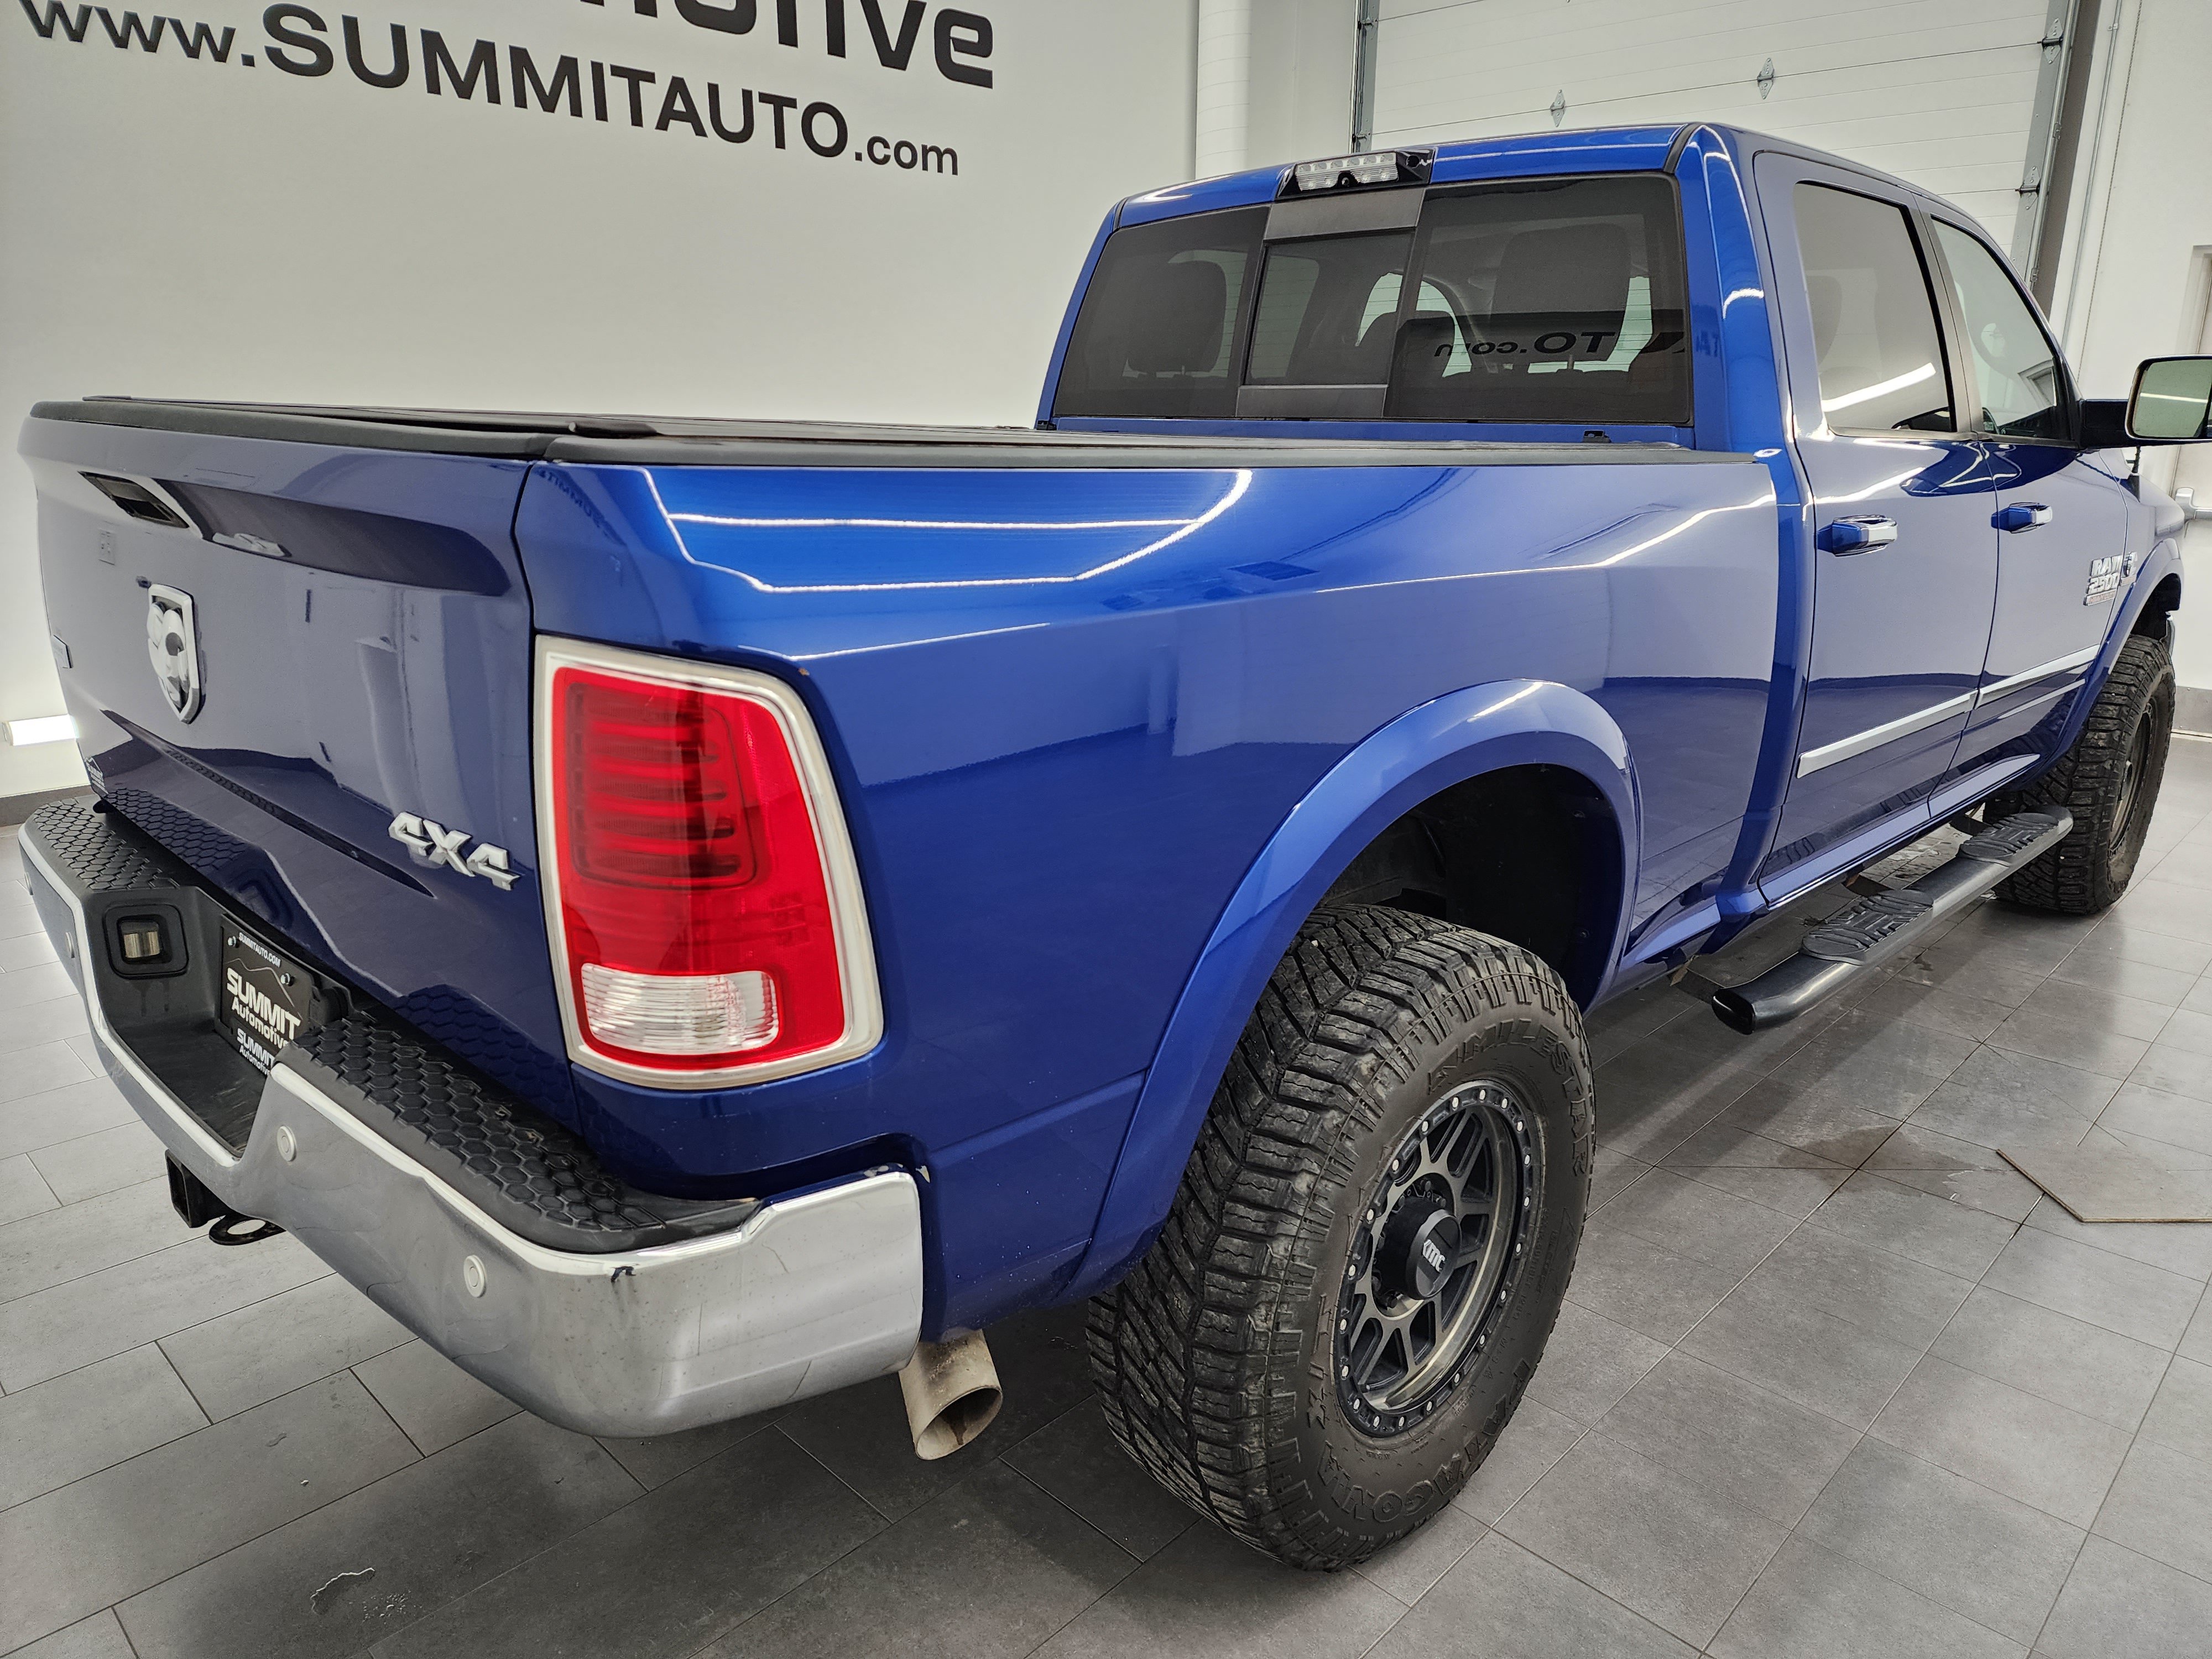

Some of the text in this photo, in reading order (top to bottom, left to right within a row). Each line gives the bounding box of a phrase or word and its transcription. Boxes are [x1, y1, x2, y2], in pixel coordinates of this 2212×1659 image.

[19, 0, 958, 175] www.SUMMITAUTO.com
[2090, 554, 2124, 577] RAM
[238, 932, 281, 968] SUMMITAUTO.COM
[227, 967, 301, 1040] SUMMIT
